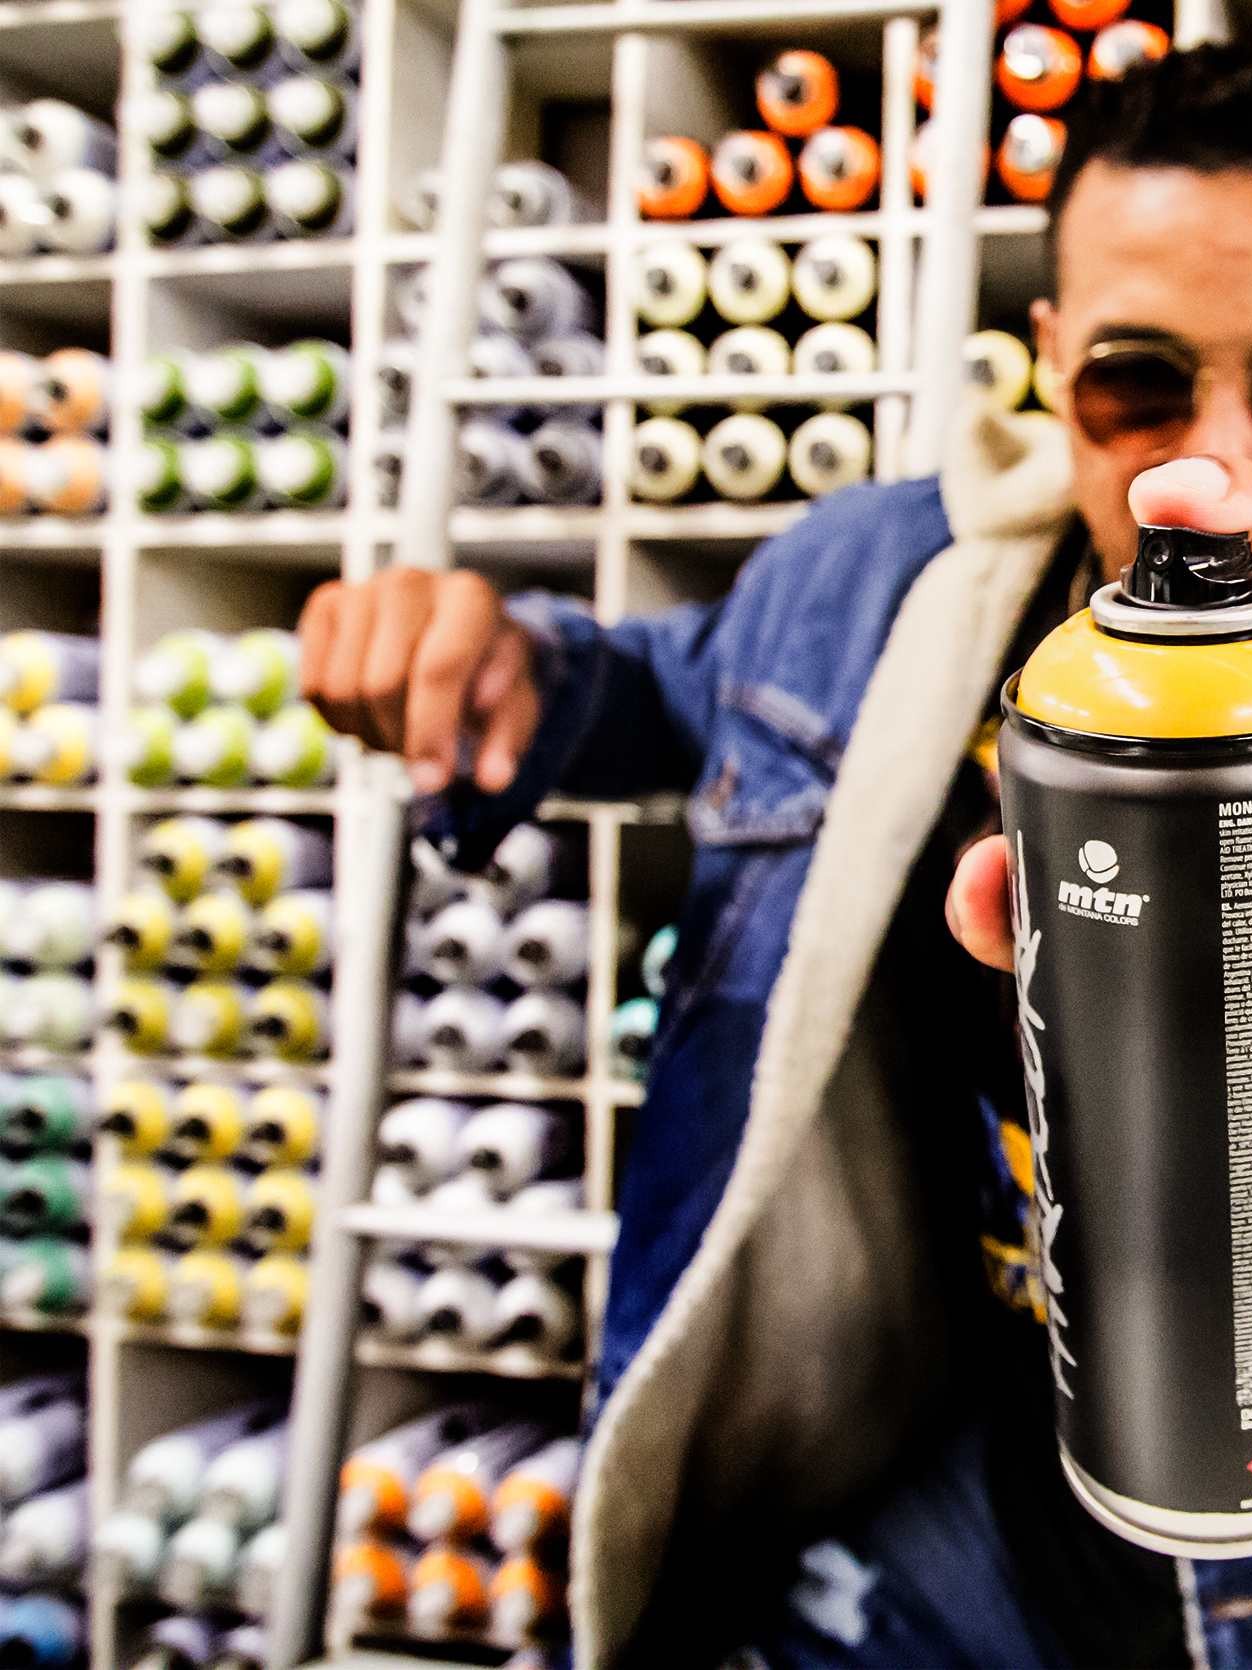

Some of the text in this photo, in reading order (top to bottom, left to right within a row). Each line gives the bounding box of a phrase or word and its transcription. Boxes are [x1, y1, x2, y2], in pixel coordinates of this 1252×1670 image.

[1218, 820, 1236, 828] ENG.
[1058, 880, 1142, 917] mtn
[1067, 904, 1103, 920] MONTANA
[1104, 913, 1139, 926] COLORS
